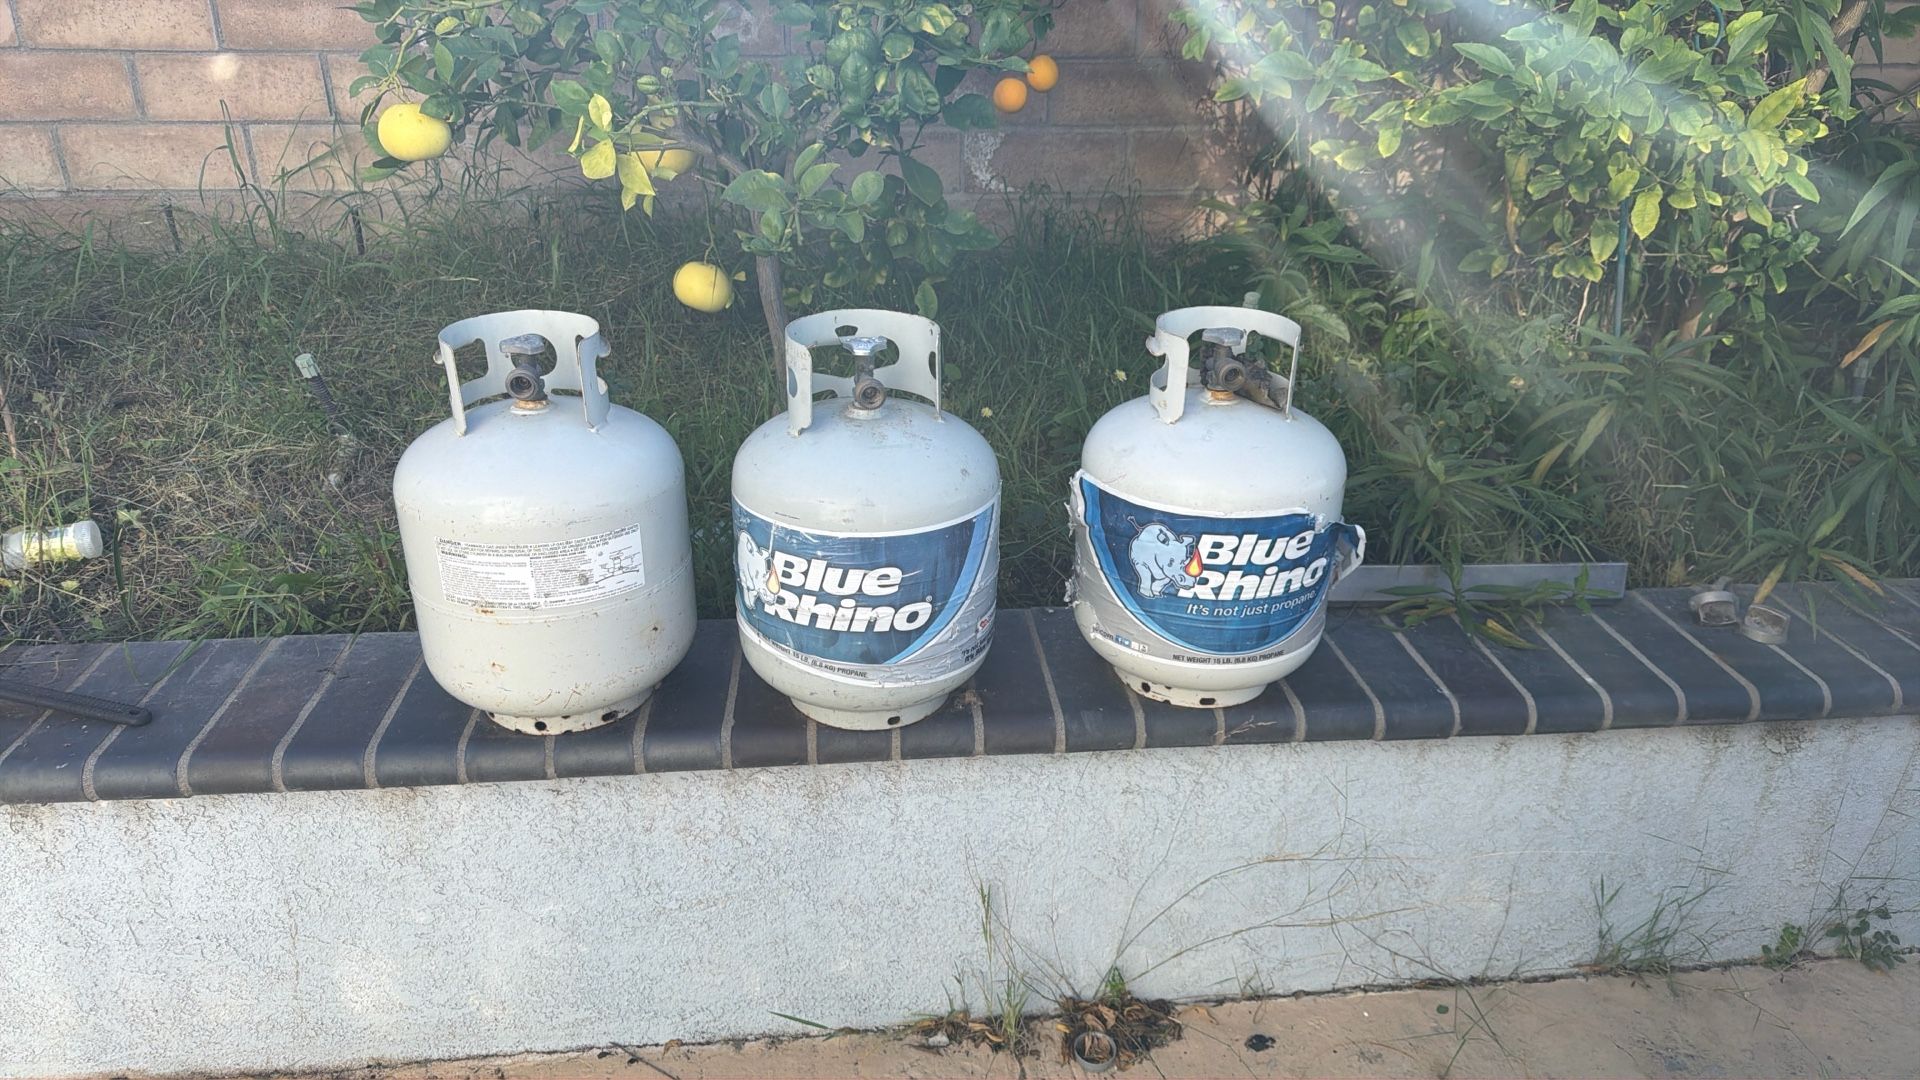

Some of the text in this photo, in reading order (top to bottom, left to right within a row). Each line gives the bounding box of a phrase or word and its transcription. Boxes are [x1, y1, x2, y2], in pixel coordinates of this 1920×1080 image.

[1198, 530, 1316, 566] Blue
[773, 550, 902, 596] Blue
[1178, 557, 1328, 600] Rhino
[764, 588, 932, 632] Rhino
[1187, 604, 1209, 616] It's
[1213, 605, 1239, 616] not
[1240, 604, 1268, 618] just
[1259, 649, 1285, 661] PROPANE
